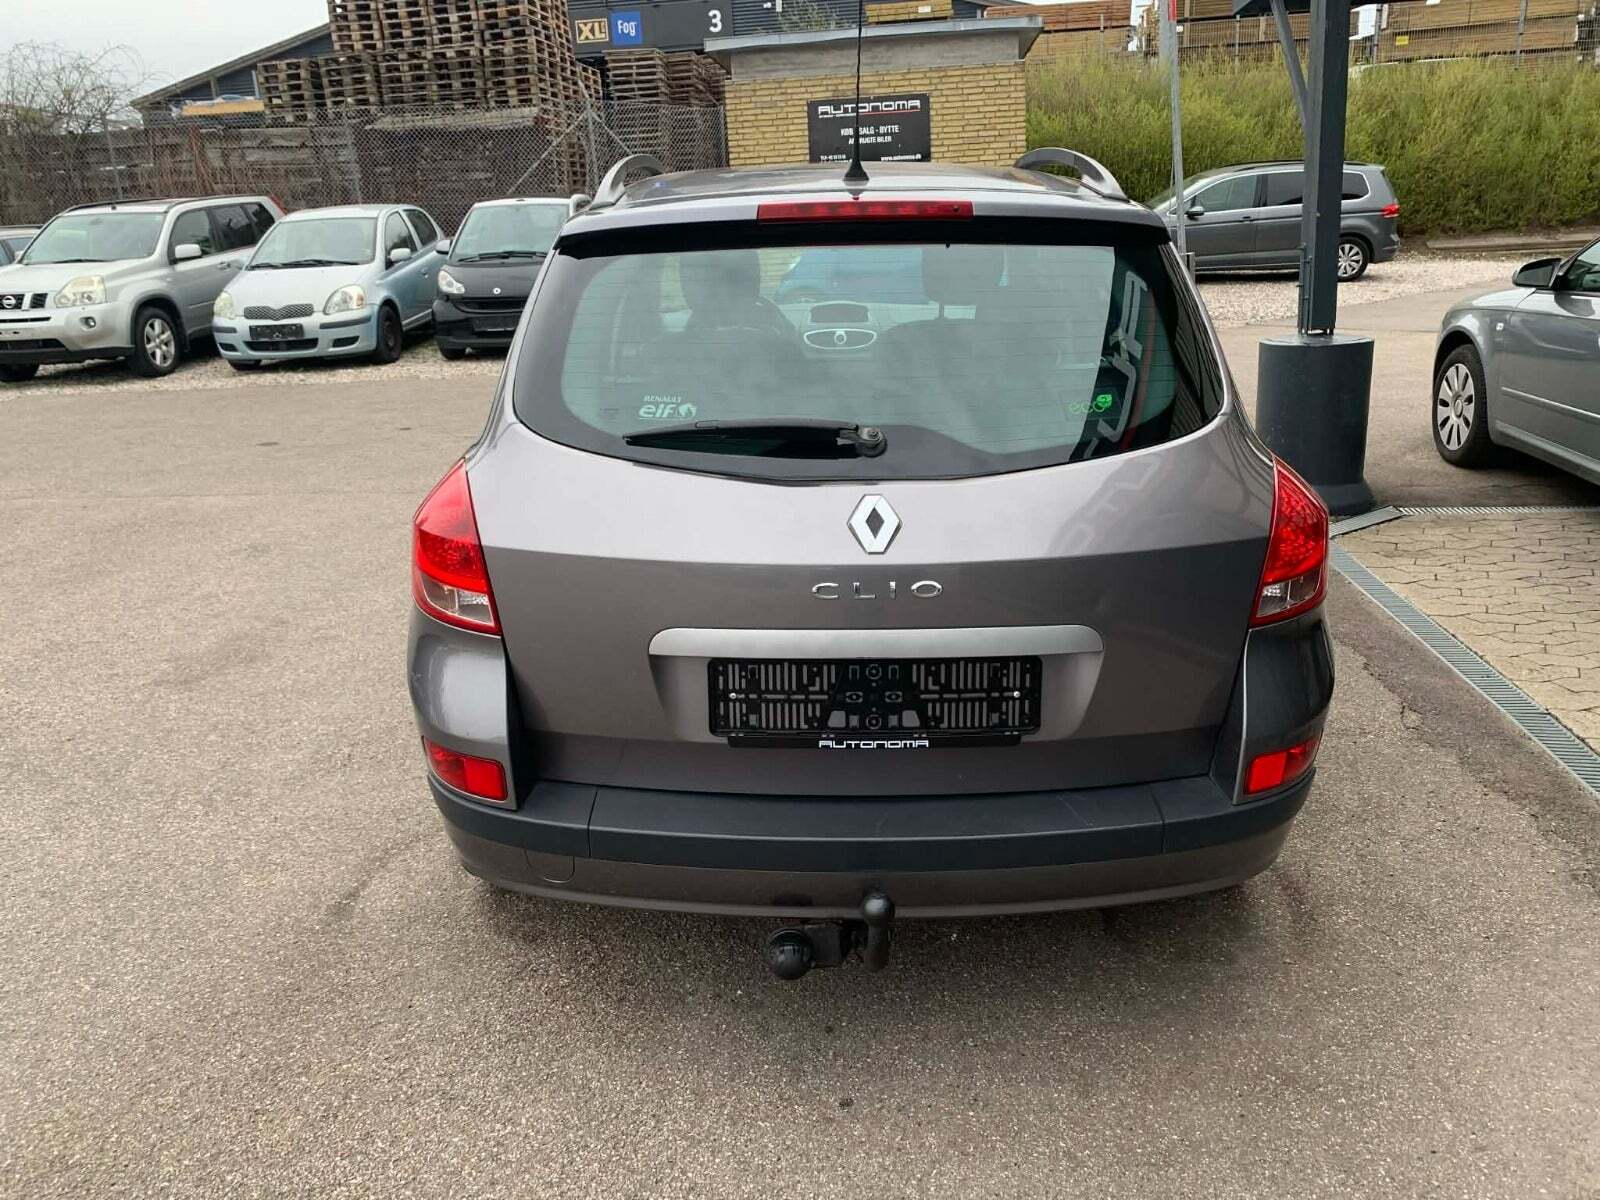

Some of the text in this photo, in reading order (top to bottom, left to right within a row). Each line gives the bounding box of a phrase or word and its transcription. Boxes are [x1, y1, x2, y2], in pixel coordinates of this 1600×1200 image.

[617, 20, 637, 37] Fog
[708, 9, 723, 33] 3
[818, 100, 921, 116] AUTONOMA
[812, 580, 943, 599] CLIO
[819, 740, 929, 749] AUTONOMA
